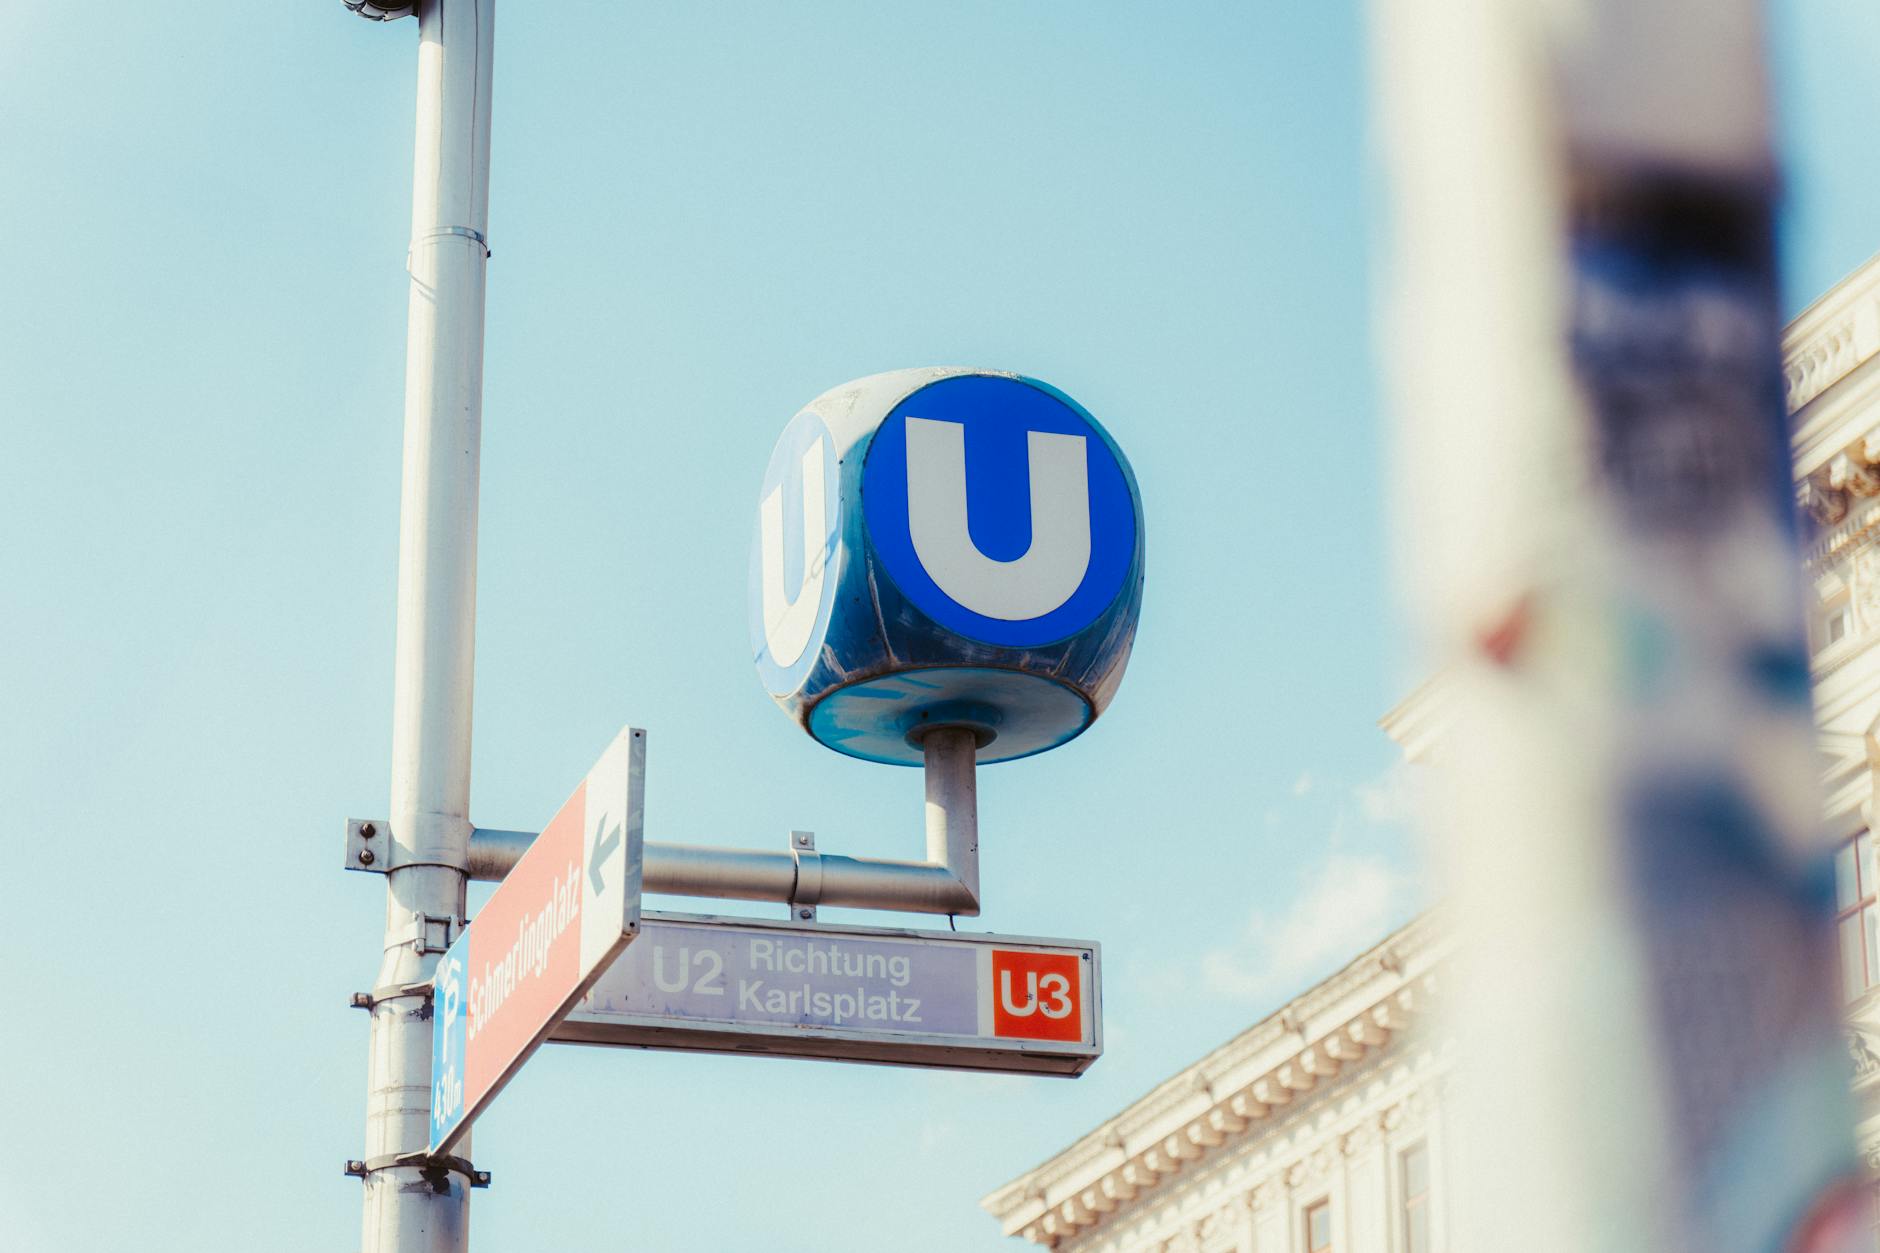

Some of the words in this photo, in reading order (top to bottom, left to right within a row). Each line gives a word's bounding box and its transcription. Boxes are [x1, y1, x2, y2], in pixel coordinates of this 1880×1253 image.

[905, 416, 1092, 621] U
[761, 434, 827, 668] U
[468, 860, 581, 1041] Schmerlingplatz
[653, 945, 725, 996] U2
[750, 939, 911, 986] Richtung
[738, 979, 923, 1025] Karlsplatz
[1001, 970, 1073, 1019] U3
